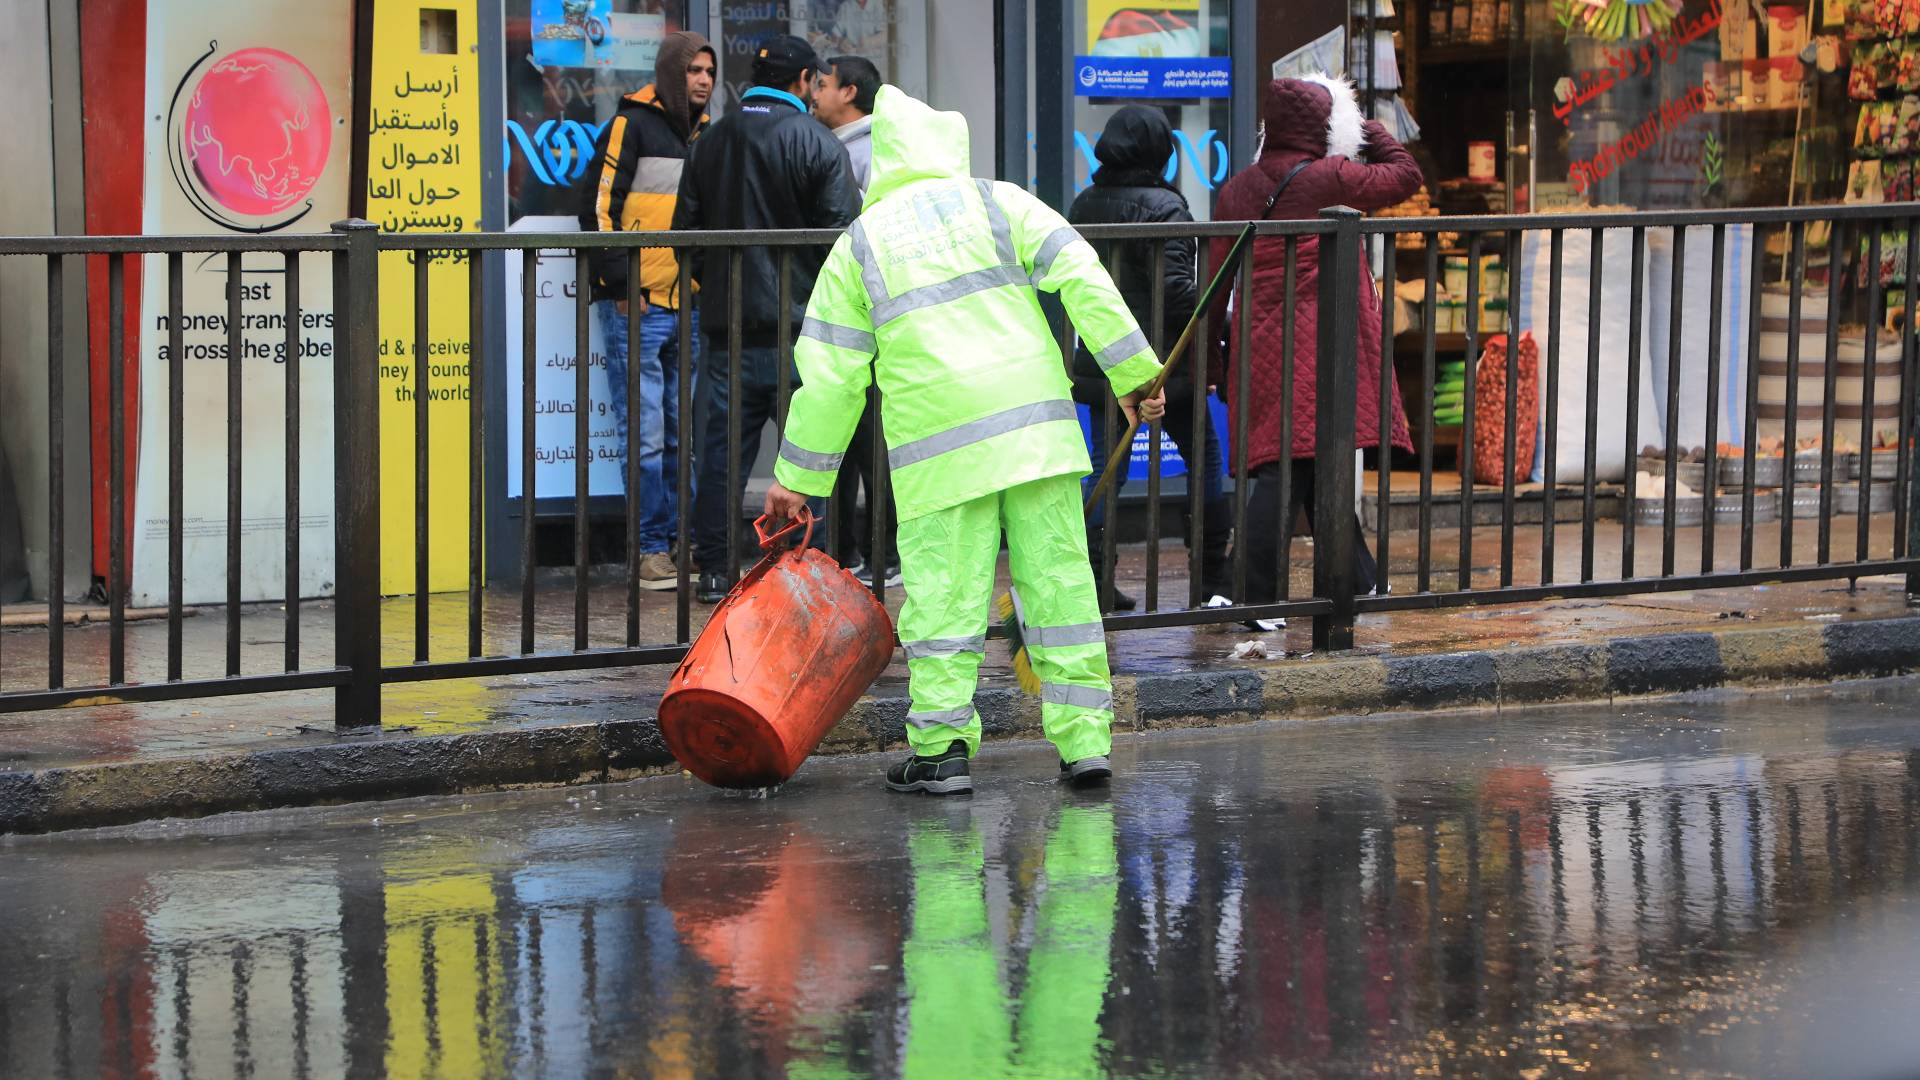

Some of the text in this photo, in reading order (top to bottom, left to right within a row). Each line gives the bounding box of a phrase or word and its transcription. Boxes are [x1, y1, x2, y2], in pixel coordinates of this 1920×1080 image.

[394, 65, 459, 98] أرسل
[369, 103, 460, 136] وأستقبل
[1659, 79, 1716, 134] Herbs
[381, 143, 460, 170] الاموال
[368, 178, 461, 205] حول العا
[225, 282, 271, 301] ast
[158, 337, 333, 364] aross he gobe
[411, 339, 470, 355] rceive
[380, 361, 471, 382] ney ound
[396, 384, 416, 401] th
